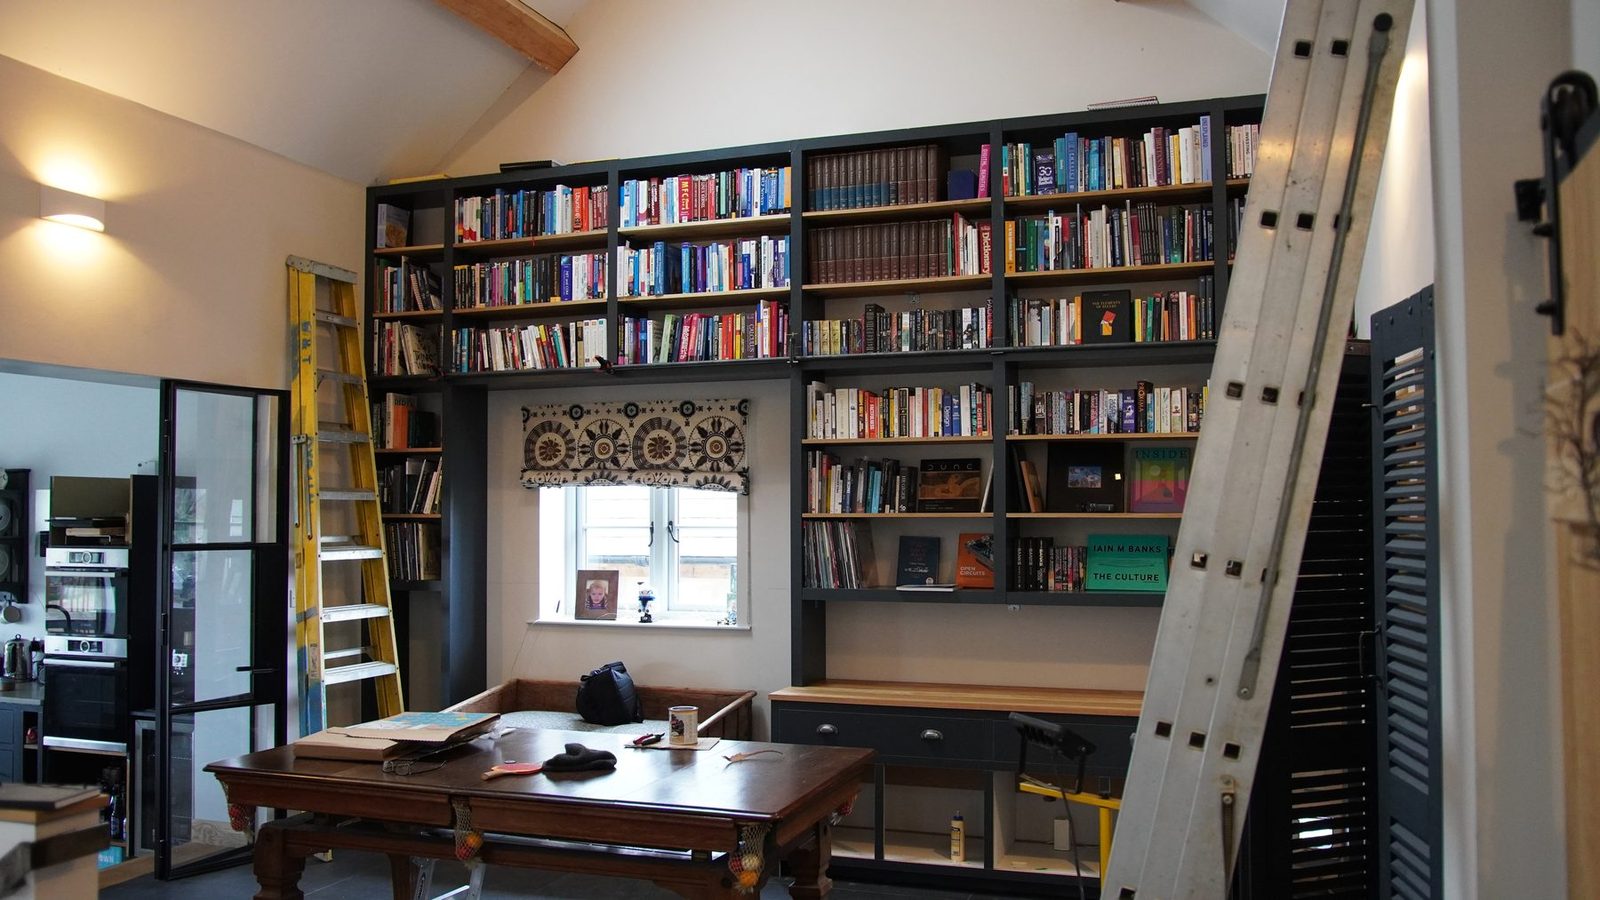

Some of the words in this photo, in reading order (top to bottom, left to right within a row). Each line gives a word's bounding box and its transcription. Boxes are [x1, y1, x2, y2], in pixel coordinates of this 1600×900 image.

[982, 232, 990, 275] Dictionary
[1135, 449, 1188, 458] INSIDE
[1094, 545, 1114, 553] IAIN
[1117, 545, 1125, 553] M
[1128, 545, 1162, 553] BANKS
